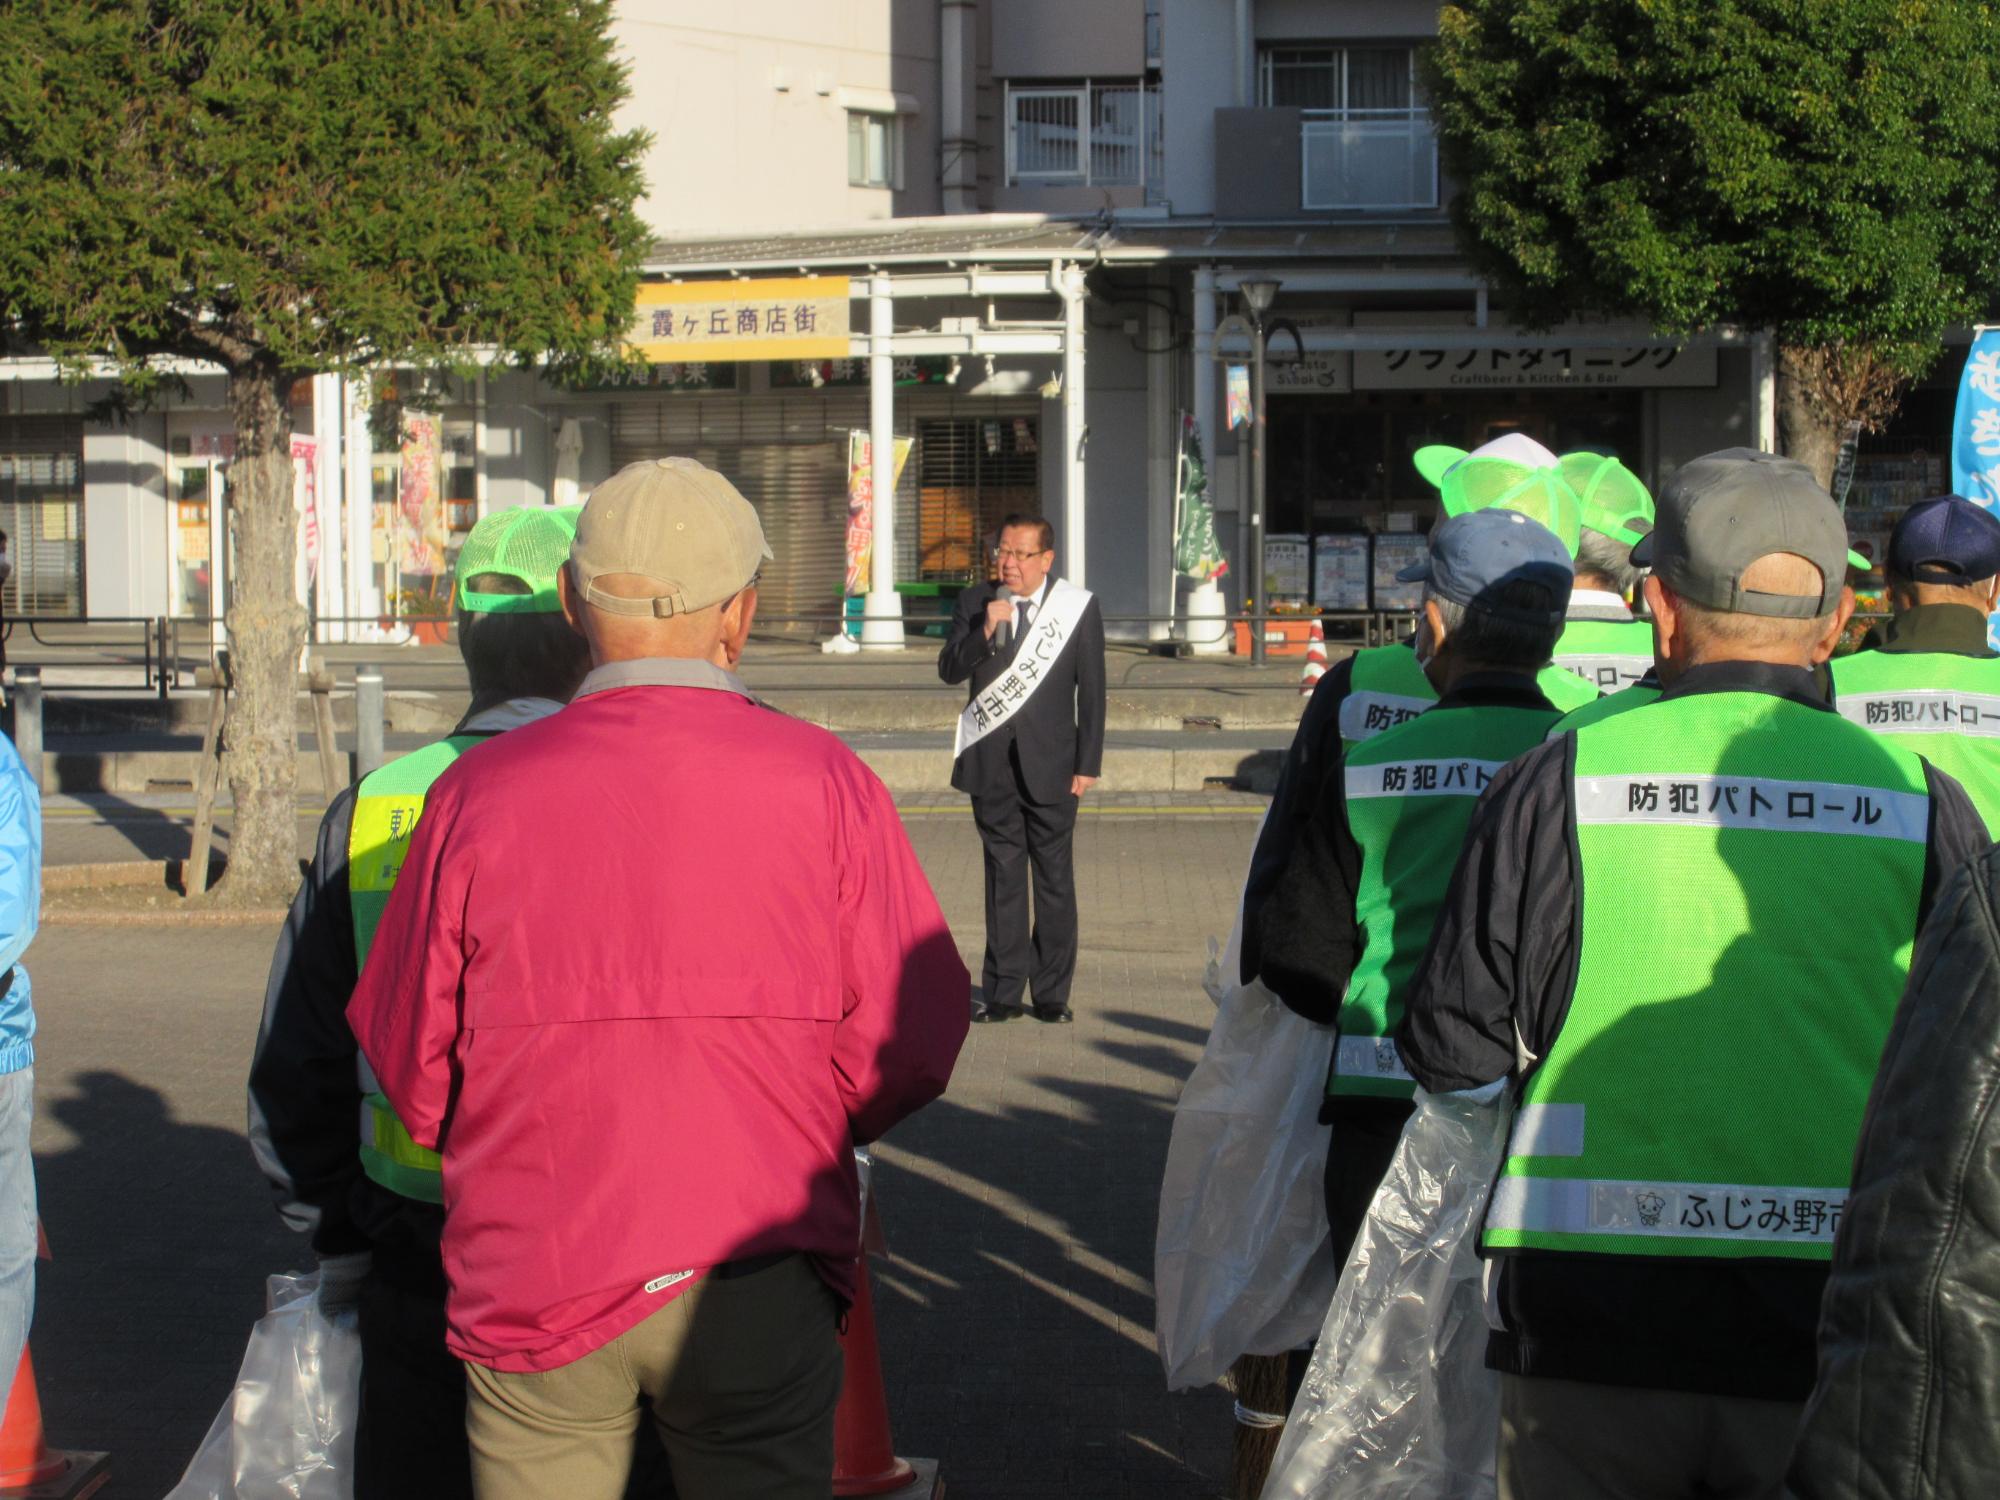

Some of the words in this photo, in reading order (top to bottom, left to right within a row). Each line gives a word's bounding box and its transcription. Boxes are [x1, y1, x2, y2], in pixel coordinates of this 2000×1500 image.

[1450, 373, 1513, 385] Craftbeer
[1516, 374, 1526, 385] &
[1530, 373, 1580, 384] Kitchen
[1584, 374, 1593, 384] &
[1598, 373, 1619, 384] Bar
[1628, 782, 1882, 825] 防犯パトロール
